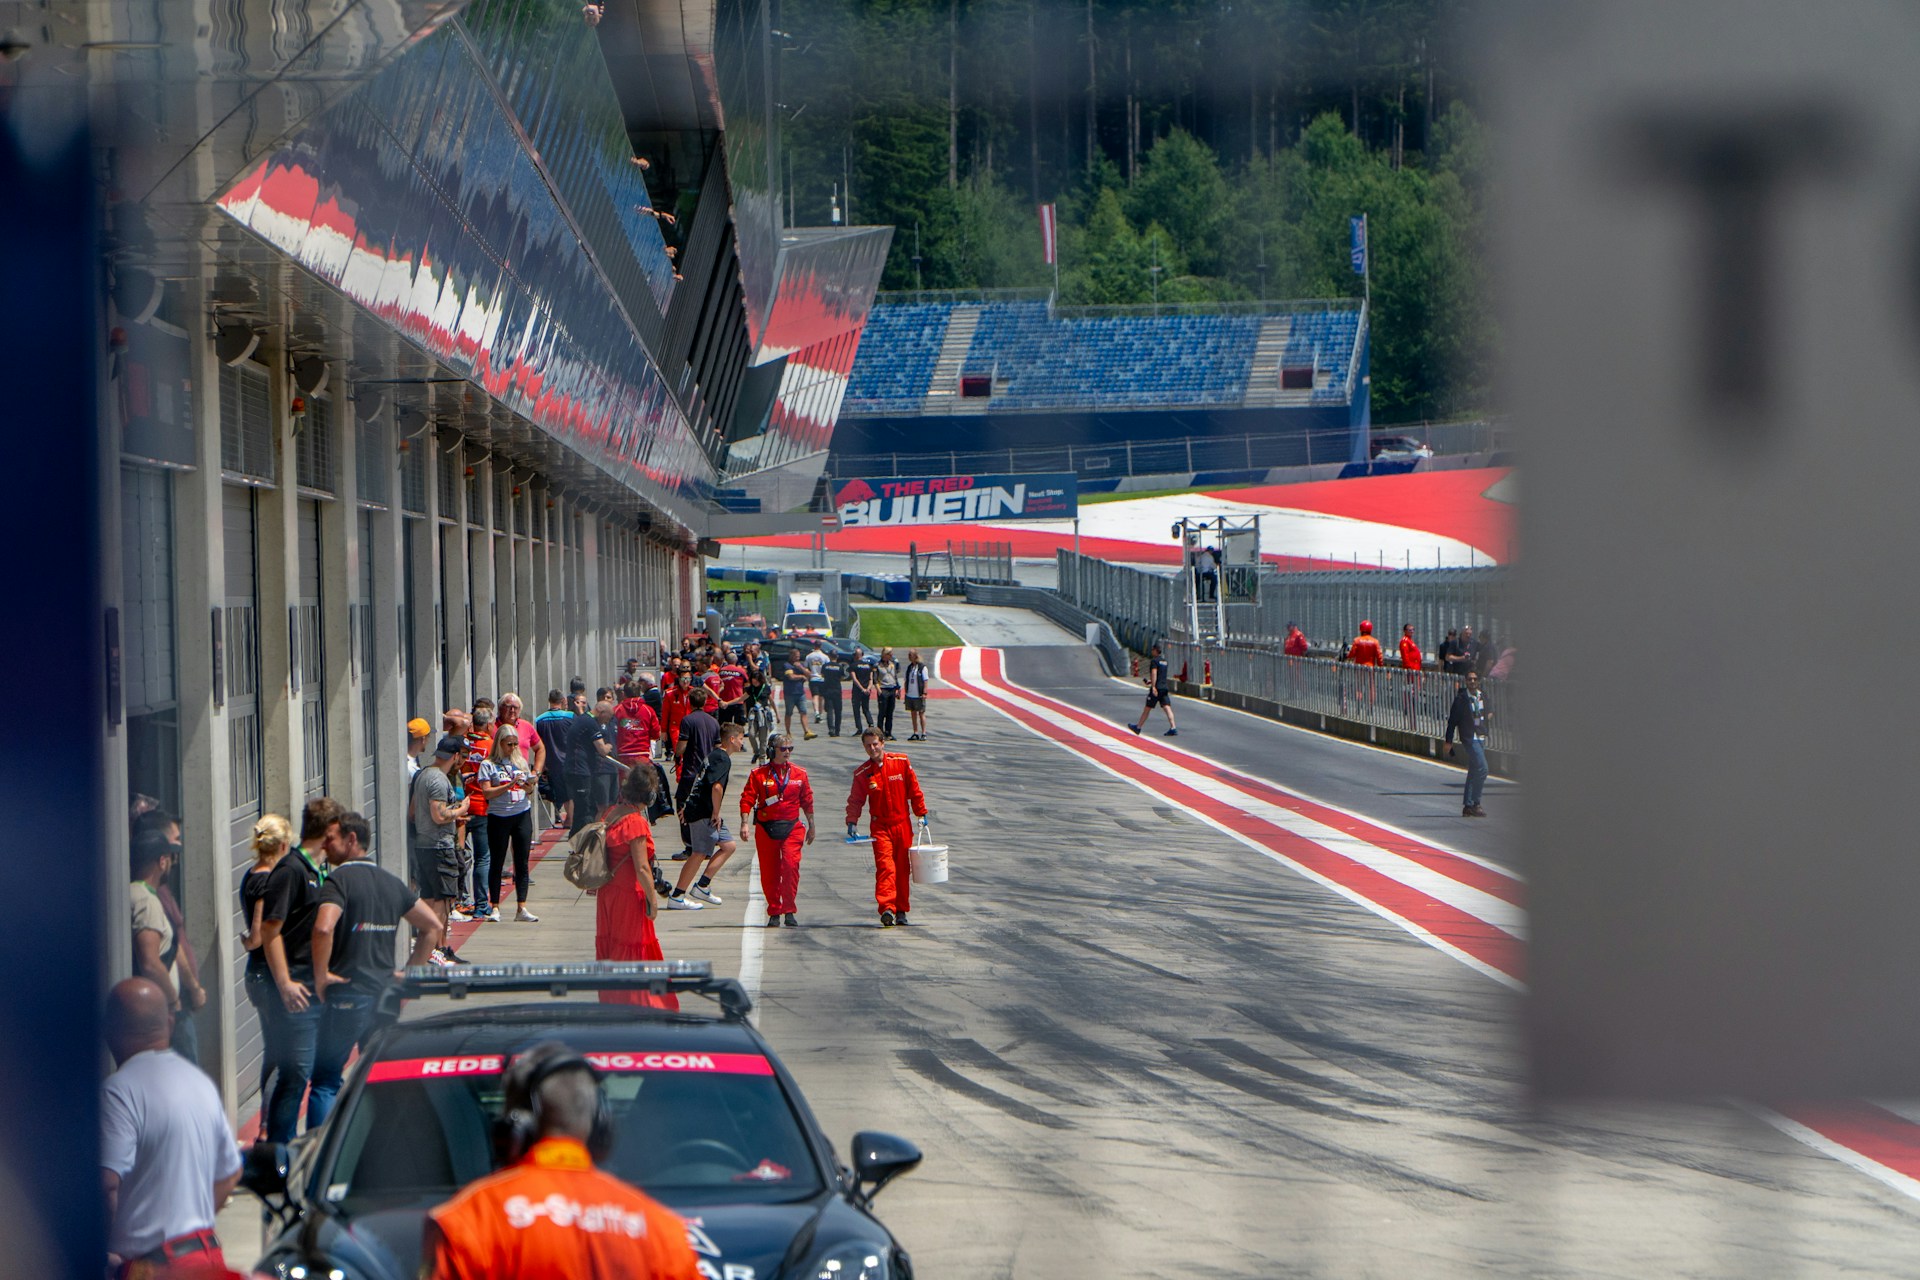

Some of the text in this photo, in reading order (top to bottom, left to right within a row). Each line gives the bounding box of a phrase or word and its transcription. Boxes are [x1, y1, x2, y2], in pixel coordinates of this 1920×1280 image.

[881, 477, 974, 497] THE RED
[422, 1055, 715, 1074] REDBNG.COM
